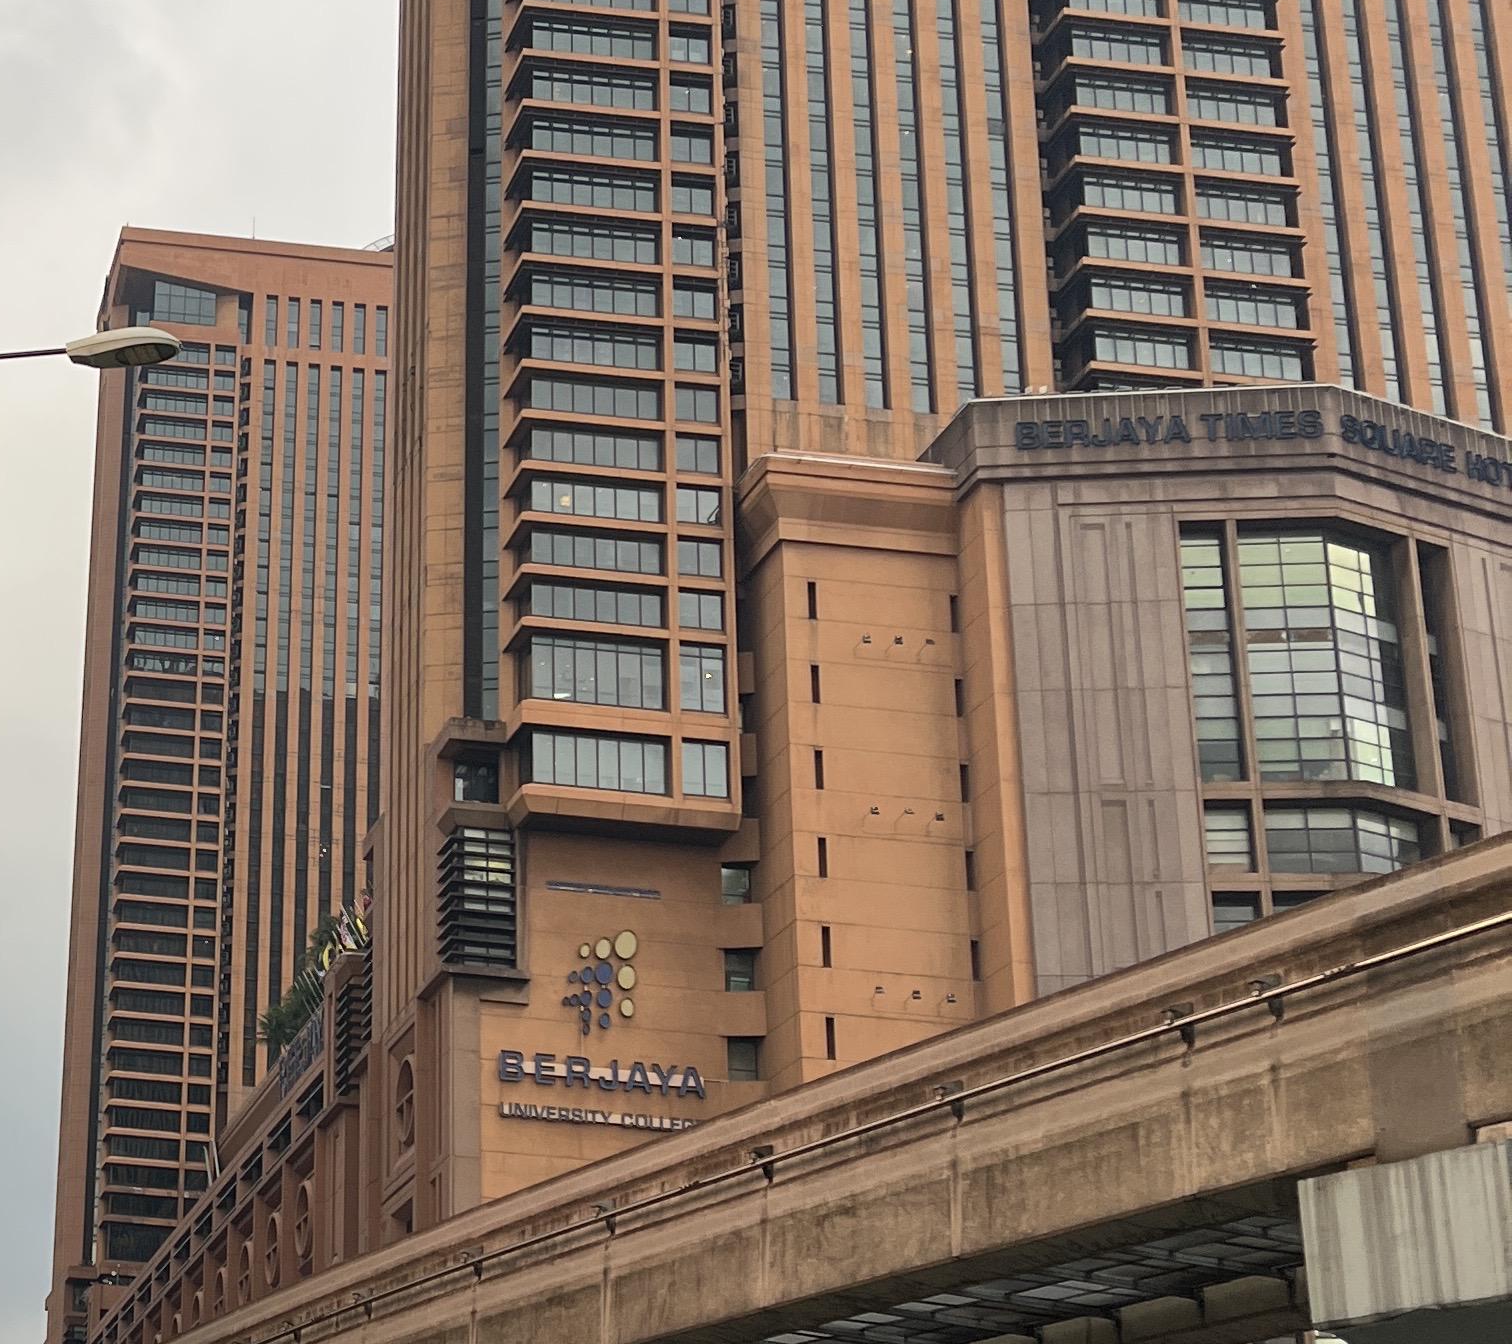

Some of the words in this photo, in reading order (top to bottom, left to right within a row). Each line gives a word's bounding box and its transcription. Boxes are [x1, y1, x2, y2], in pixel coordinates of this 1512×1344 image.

[1015, 415, 1191, 450] BERJAYA
[1200, 409, 1324, 441] TIMES
[1340, 413, 1457, 474] SQUARE
[498, 1050, 705, 1099] BERJAYA
[498, 1102, 613, 1125] UNIVERSITY
